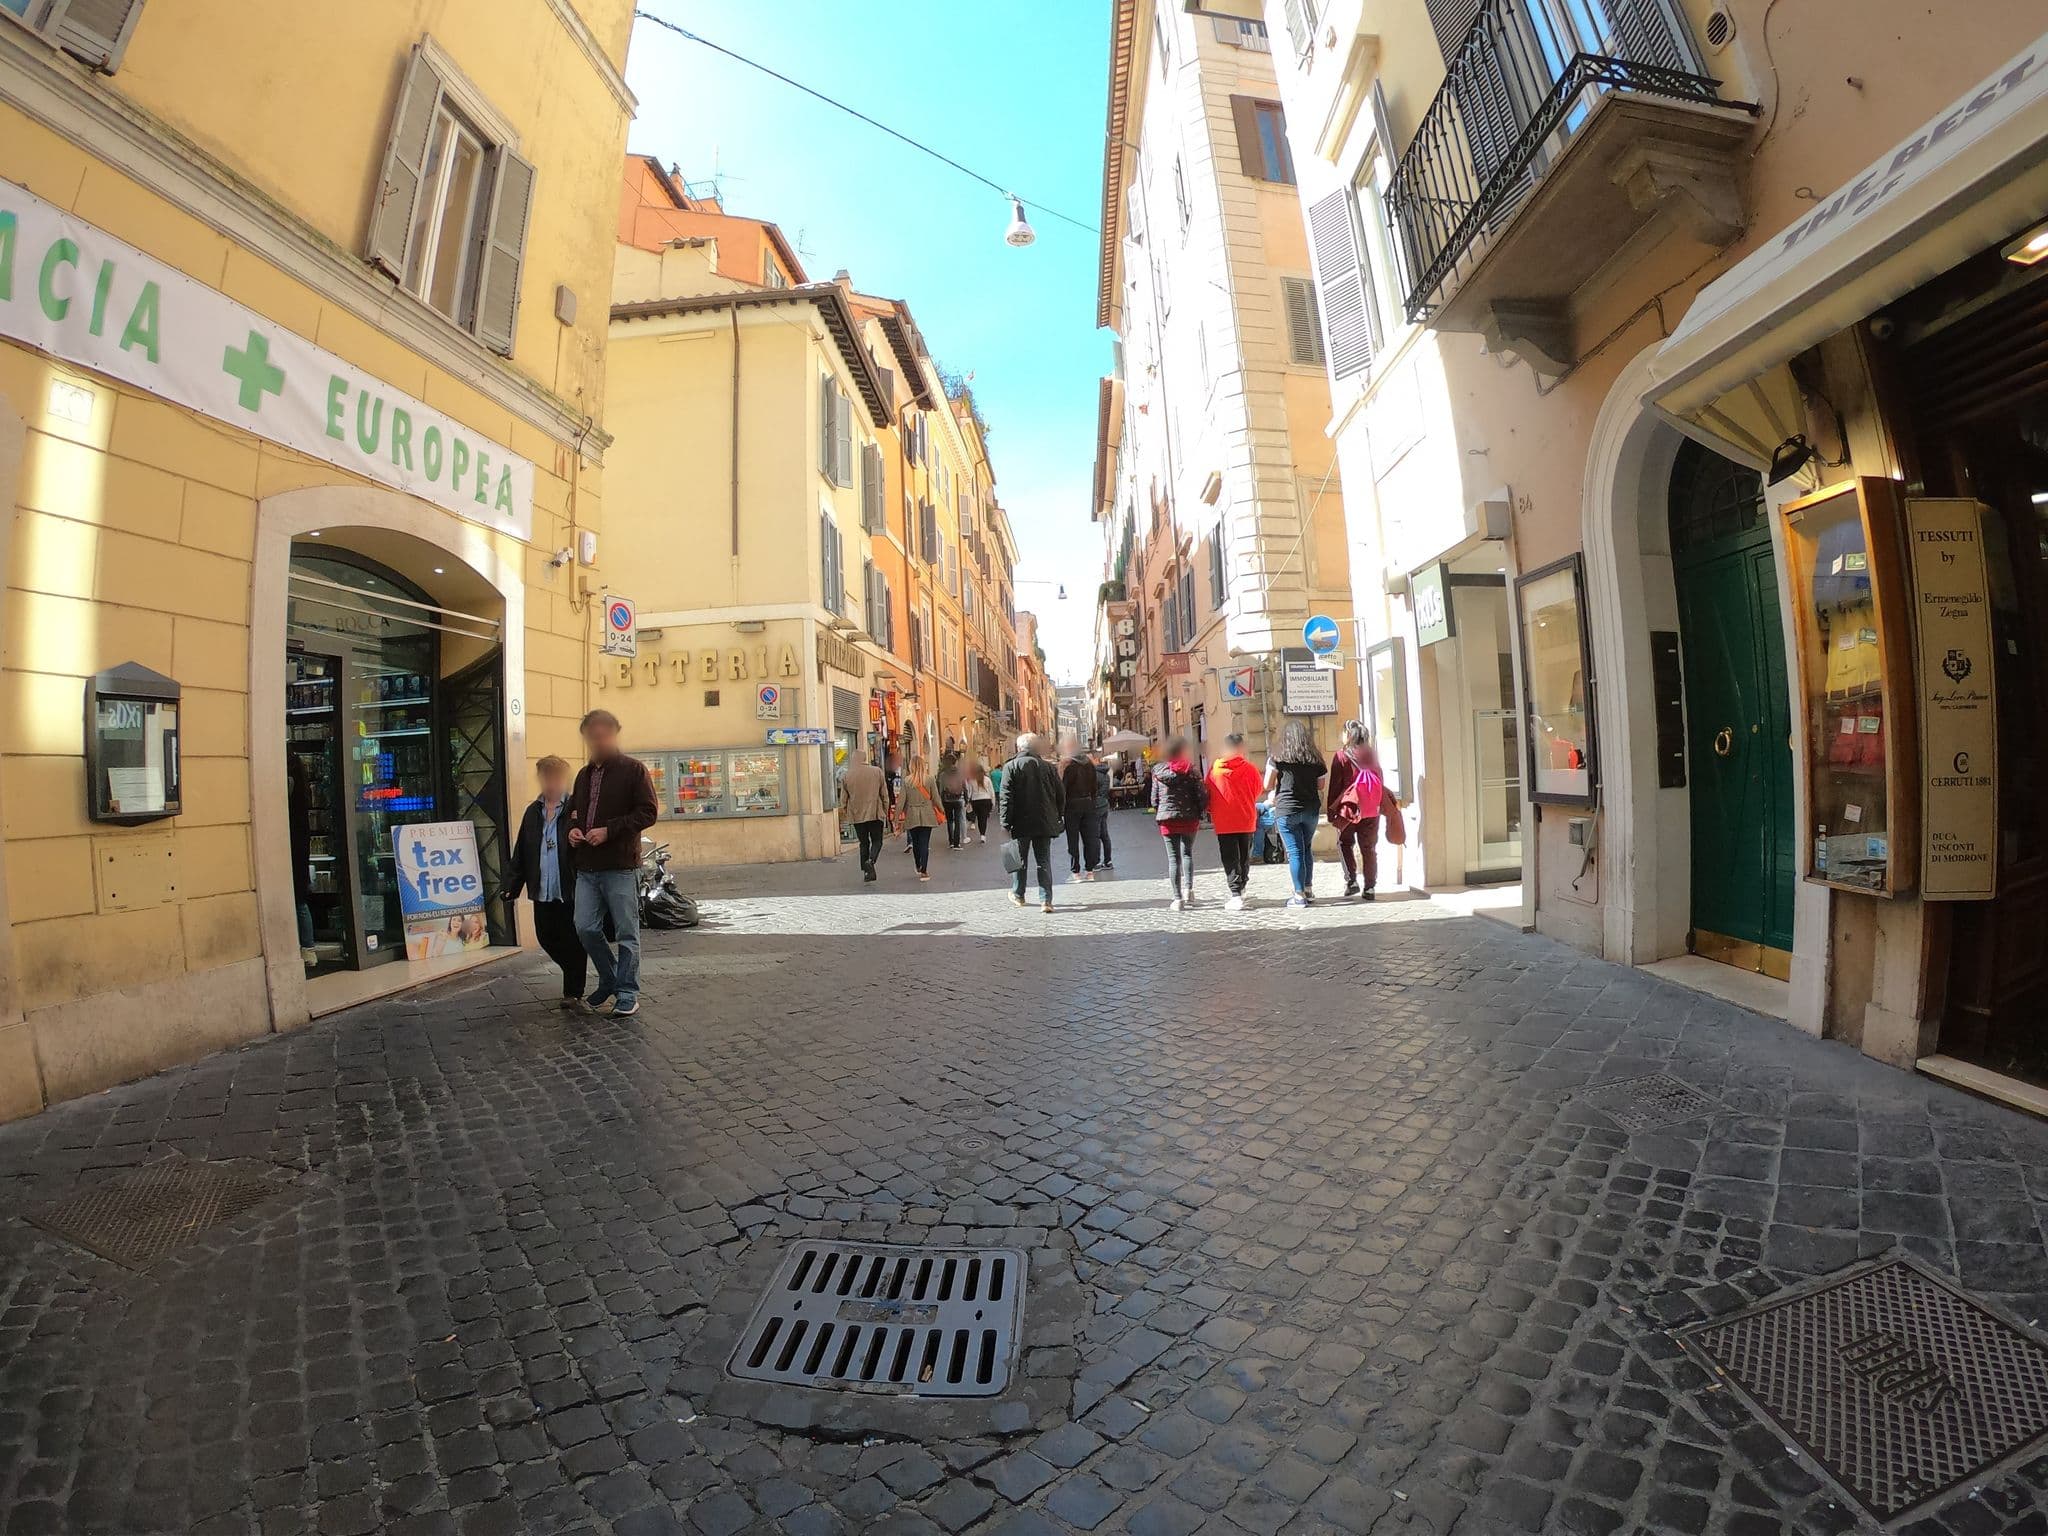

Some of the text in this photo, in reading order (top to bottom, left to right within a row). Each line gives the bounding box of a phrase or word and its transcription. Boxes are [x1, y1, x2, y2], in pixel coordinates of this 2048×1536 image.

[1782, 54, 2036, 250] THE BEST
[1852, 172, 1905, 217] OF
[325, 375, 516, 517] EUROPEA
[1917, 530, 1974, 543] TESSUTI
[1940, 550, 1956, 567] by
[1924, 592, 1983, 606] Ermenegildo
[1939, 606, 1969, 619] Zegna
[599, 640, 800, 689] ETTERIA
[1931, 776, 1992, 787] CERRUTI 1881
[410, 825, 473, 839] PREMIER
[1932, 832, 1958, 842] DUCA
[412, 841, 464, 868] tax
[1932, 843, 1975, 852] VISCONTI
[1931, 853, 1988, 863] DI MODRONE
[416, 870, 477, 900] free
